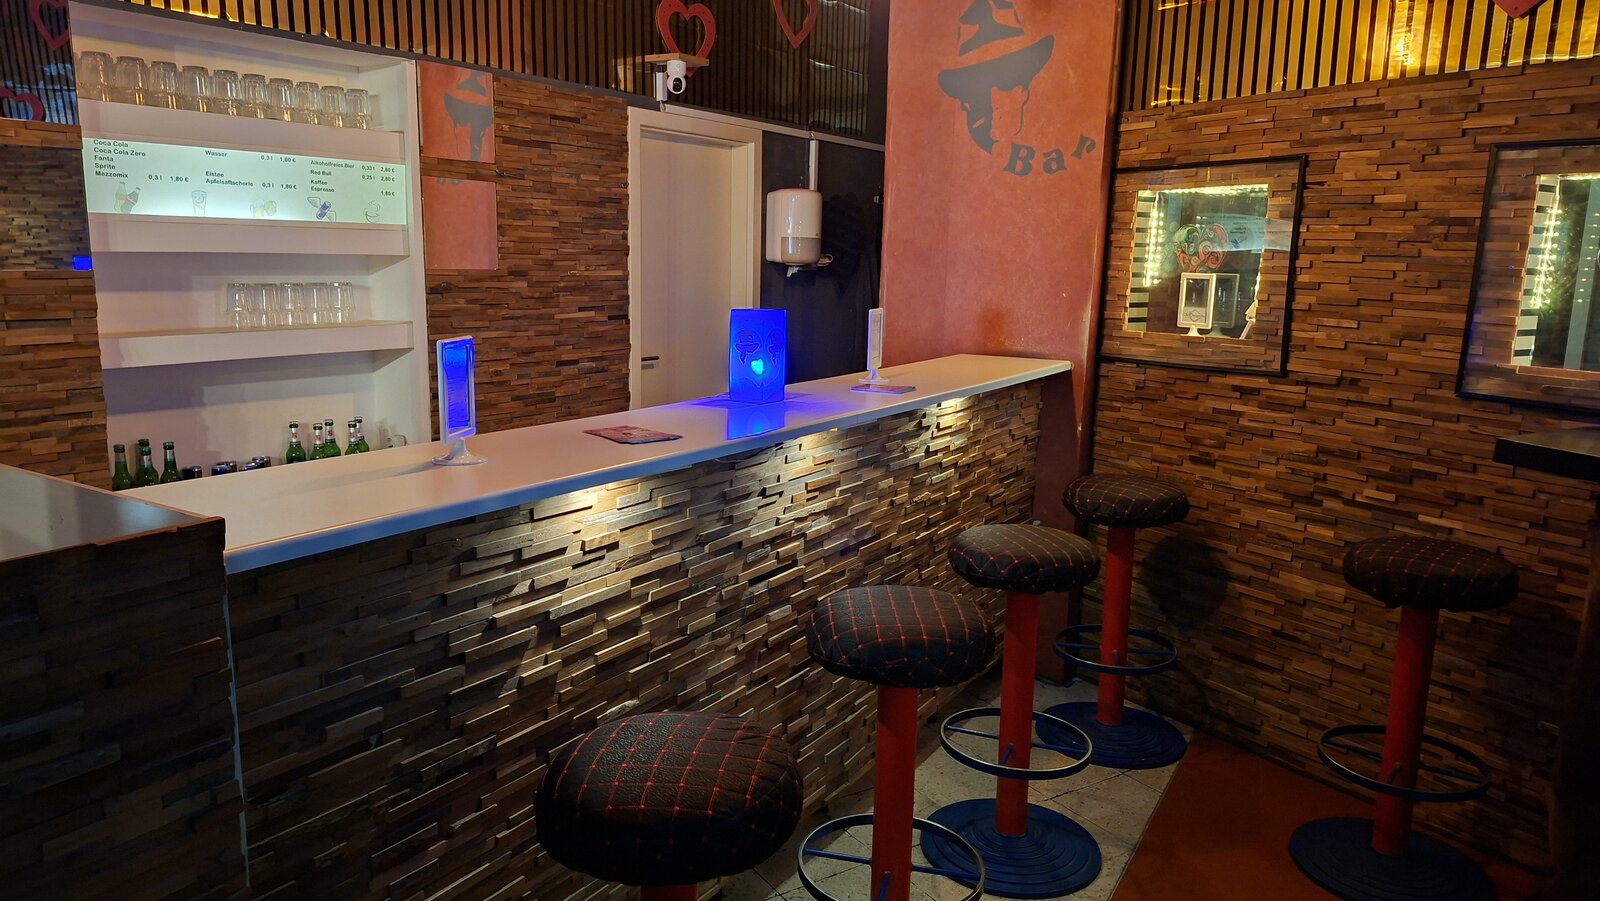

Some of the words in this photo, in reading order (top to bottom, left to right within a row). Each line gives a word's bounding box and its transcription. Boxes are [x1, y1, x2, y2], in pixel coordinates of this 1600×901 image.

[1003, 134, 1096, 177] Bar
[94, 162, 116, 170] Sprite
[310, 160, 343, 168] Alkoholfreies
[95, 170, 129, 178] Mezzomix
[205, 178, 254, 187] Apfelsaftschorle
